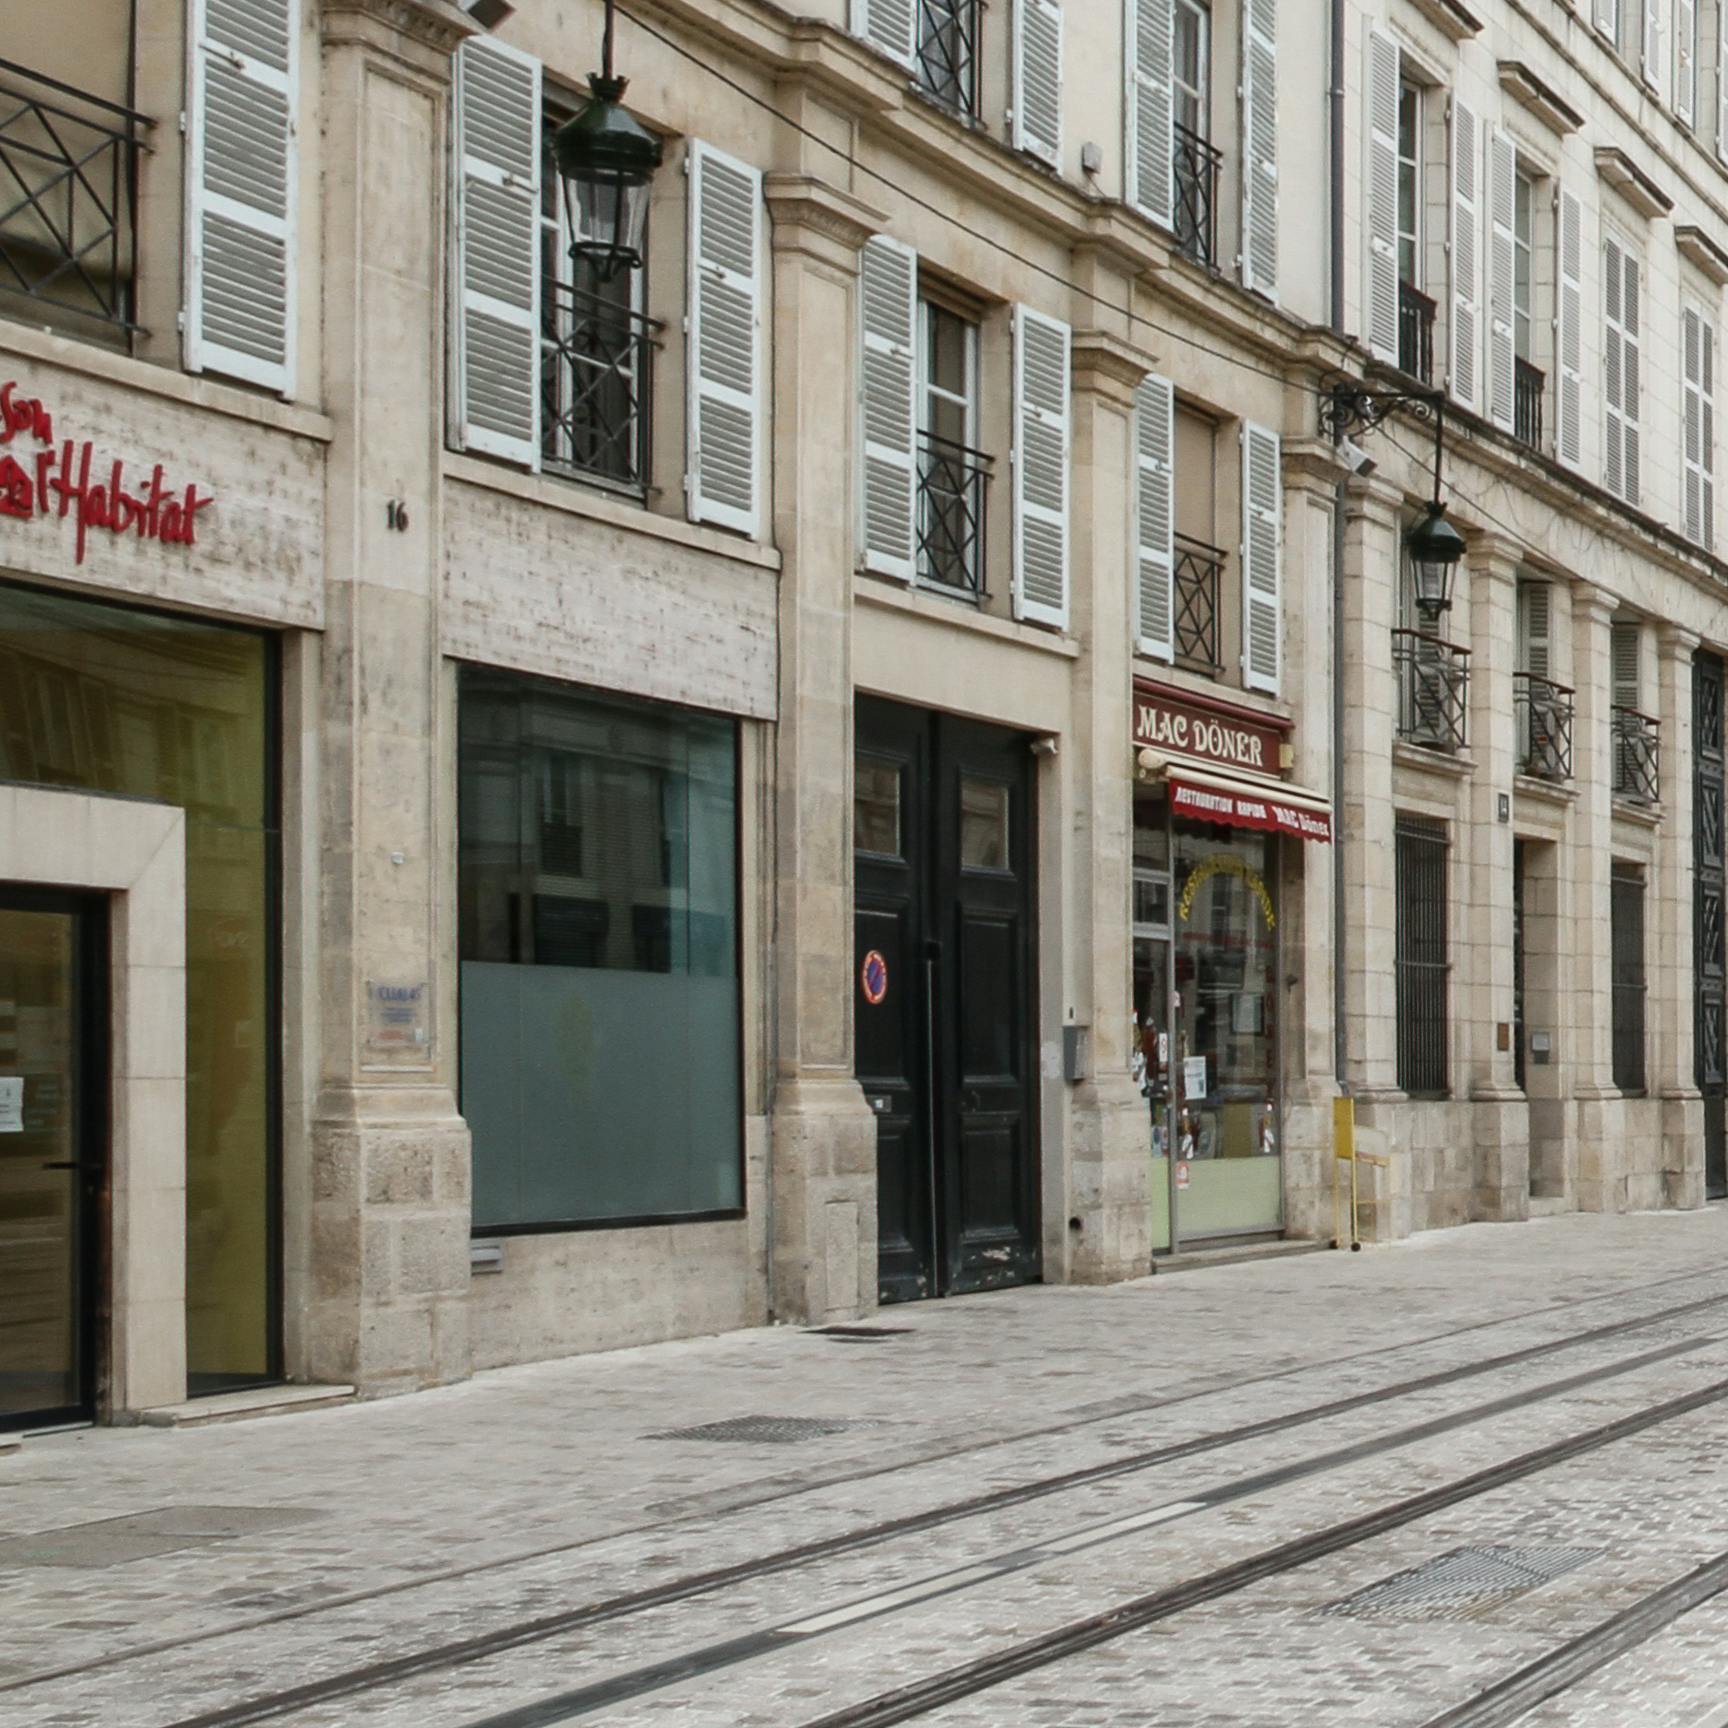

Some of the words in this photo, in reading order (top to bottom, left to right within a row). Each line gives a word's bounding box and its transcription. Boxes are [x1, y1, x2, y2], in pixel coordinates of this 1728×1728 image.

[0, 382, 53, 445] son
[36, 439, 214, 565] l'Habitat
[386, 499, 409, 533] 16
[1137, 704, 1189, 748] MAC
[1192, 719, 1263, 767] DÖNER
